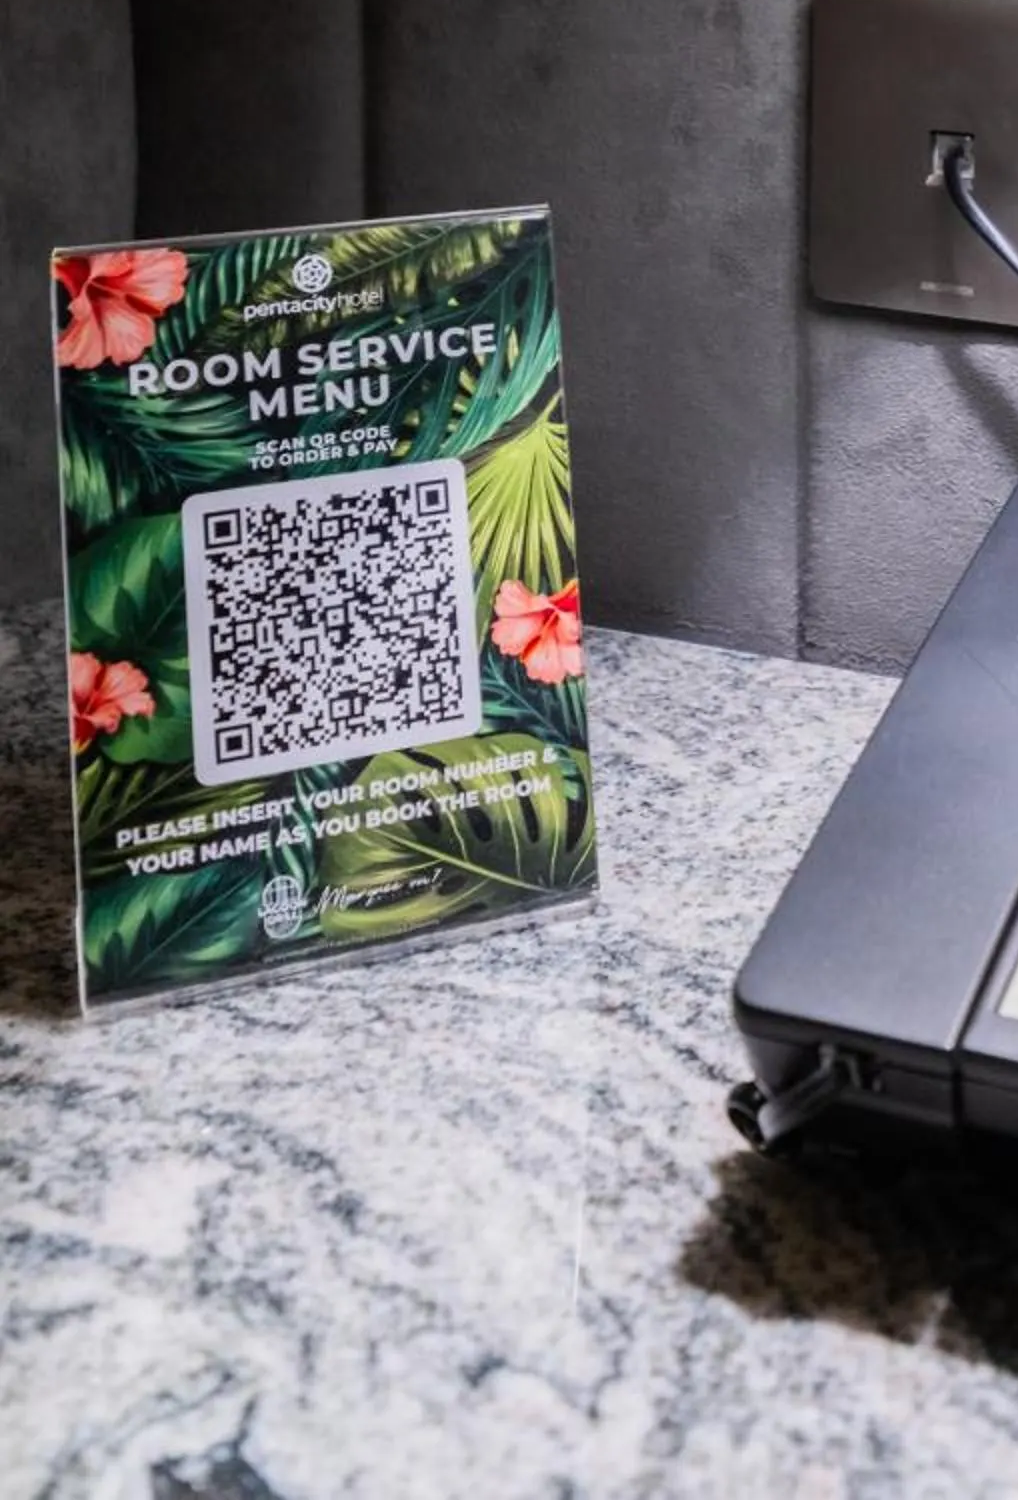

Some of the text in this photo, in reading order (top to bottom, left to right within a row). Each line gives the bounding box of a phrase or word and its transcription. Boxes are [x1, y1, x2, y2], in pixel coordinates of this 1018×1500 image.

[243, 286, 384, 322] pentacityhotel
[128, 323, 497, 397] ROOM SERVICE
[249, 373, 390, 422] MENU
[248, 438, 399, 471] TO ORDER & PAY
[255, 425, 391, 455] SCAN QR CODE
[116, 747, 557, 849] PLEASE INSERT YOUR ROOM NUMBER &
[126, 775, 552, 877] YOUR NAME AS YOU BOOK THE ROOM
